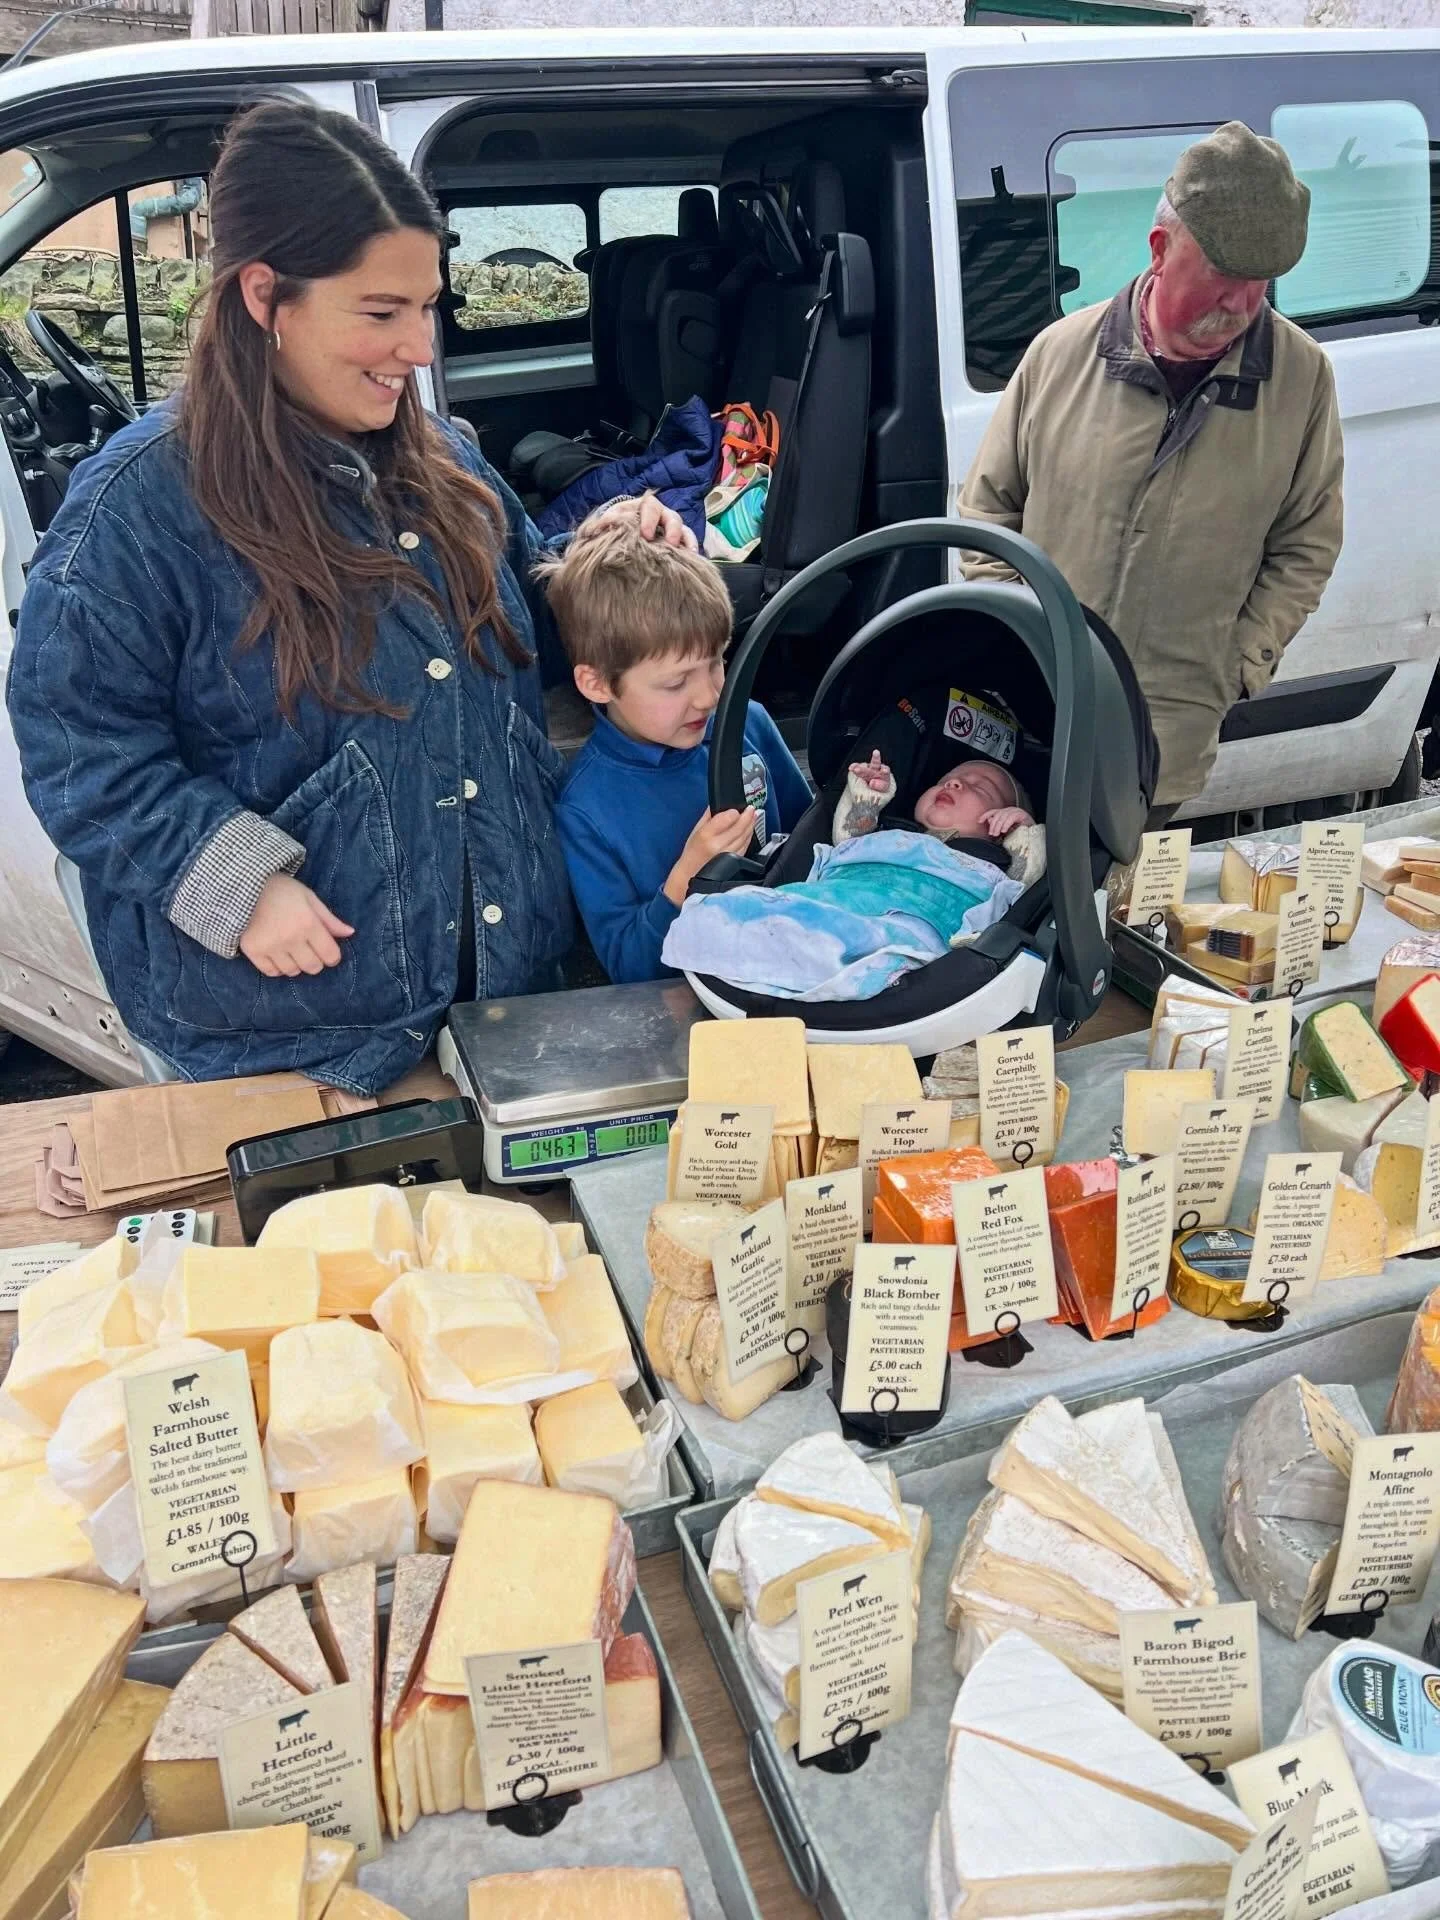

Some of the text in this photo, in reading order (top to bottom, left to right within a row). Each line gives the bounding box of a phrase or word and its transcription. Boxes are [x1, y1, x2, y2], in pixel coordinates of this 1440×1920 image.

[1330, 848, 1355, 856] Creamy
[997, 1052, 1034, 1064] Gorwydd
[996, 1063, 1037, 1076] Caerphilly
[609, 1118, 628, 1126] UNIT
[531, 1128, 565, 1138] WEIGHT
[705, 1128, 752, 1138] Worcester
[881, 1127, 928, 1135] Worcester
[1024, 1125, 1040, 1134] 100g
[1185, 1125, 1243, 1135] Cornish Yarg
[714, 1141, 738, 1149] Gold
[893, 1138, 915, 1147] Hop
[1268, 1181, 1331, 1191] Golden Cenarth
[804, 1201, 847, 1217] Monkland
[984, 1203, 1017, 1216] Belton
[981, 1215, 1024, 1230] Red Fox
[730, 1236, 772, 1267] Monkland
[1270, 1241, 1312, 1249] PASTEURISED
[805, 1248, 846, 1261] VEGETARIAN
[826, 1256, 842, 1267] MILK
[1268, 1254, 1308, 1265] £7.50 each
[740, 1255, 765, 1274] Garlic
[983, 1259, 1032, 1274] VEGETARIAN
[878, 1275, 928, 1285] Snowdonia
[983, 1266, 1034, 1283] PASTEURISED
[863, 1288, 941, 1300] Black Bomber
[985, 1279, 1037, 1298] £2.20 100g
[739, 1291, 779, 1318] VEGETARIAN
[860, 1302, 877, 1310] Rich
[913, 1303, 941, 1311] cheddar
[985, 1303, 997, 1312] UK
[746, 1302, 776, 1324] RAW MILK
[739, 1310, 785, 1345] £3.30 100g
[750, 1331, 773, 1348] LOCAL
[871, 1338, 924, 1346] VEGETARIAN
[870, 1347, 925, 1355] PASTEURISED
[868, 1361, 922, 1372] £5.00 each
[168, 1396, 210, 1415] Welsh
[152, 1410, 230, 1437] Farmhouse
[149, 1426, 239, 1457] Salted Butter
[152, 1441, 241, 1472] The best dairy butter
[149, 1451, 248, 1485] salted in the traditional
[151, 1466, 248, 1497] Welsh farmhouse way.
[1369, 1469, 1433, 1482] Montagnolo
[168, 1484, 237, 1509] VEGETARIAN
[1383, 1485, 1415, 1495] Affine
[169, 1495, 240, 1521] PASTEURISED
[165, 1522, 202, 1547] £1.85
[219, 1511, 249, 1529] 100g
[1361, 1554, 1414, 1563] VEGETARIAN
[1358, 1562, 1413, 1573] PASTEURISED
[1351, 1575, 1411, 1590] £2.20 100g
[829, 1594, 883, 1619] Perl Wen
[1144, 1636, 1234, 1651] Baron Bigod
[1133, 1651, 1247, 1666] Farmhouse Brie
[506, 1668, 565, 1681] Smoked
[827, 1663, 886, 1689] VEGETARIAN
[482, 1675, 592, 1693] Little Hereford
[826, 1671, 888, 1699] PASTEURISED
[823, 1684, 891, 1718] £2.75 100g
[1398, 1679, 1409, 1733] BLUE MONK
[1158, 1714, 1231, 1726] PASTEURISED
[508, 1730, 578, 1743] VEGETARIAN
[1159, 1730, 1192, 1741] £3.95
[1207, 1727, 1232, 1737] 100g
[275, 1731, 317, 1752] Little
[518, 1737, 570, 1748] RAW MILK
[262, 1740, 334, 1773] Hereford
[505, 1745, 585, 1767] £3.30 100g
[524, 1760, 564, 1773] LOCAL
[1267, 1798, 1295, 1816] Blue
[321, 1824, 352, 1838] 100g
[1307, 1879, 1352, 1905] RAW MILK
